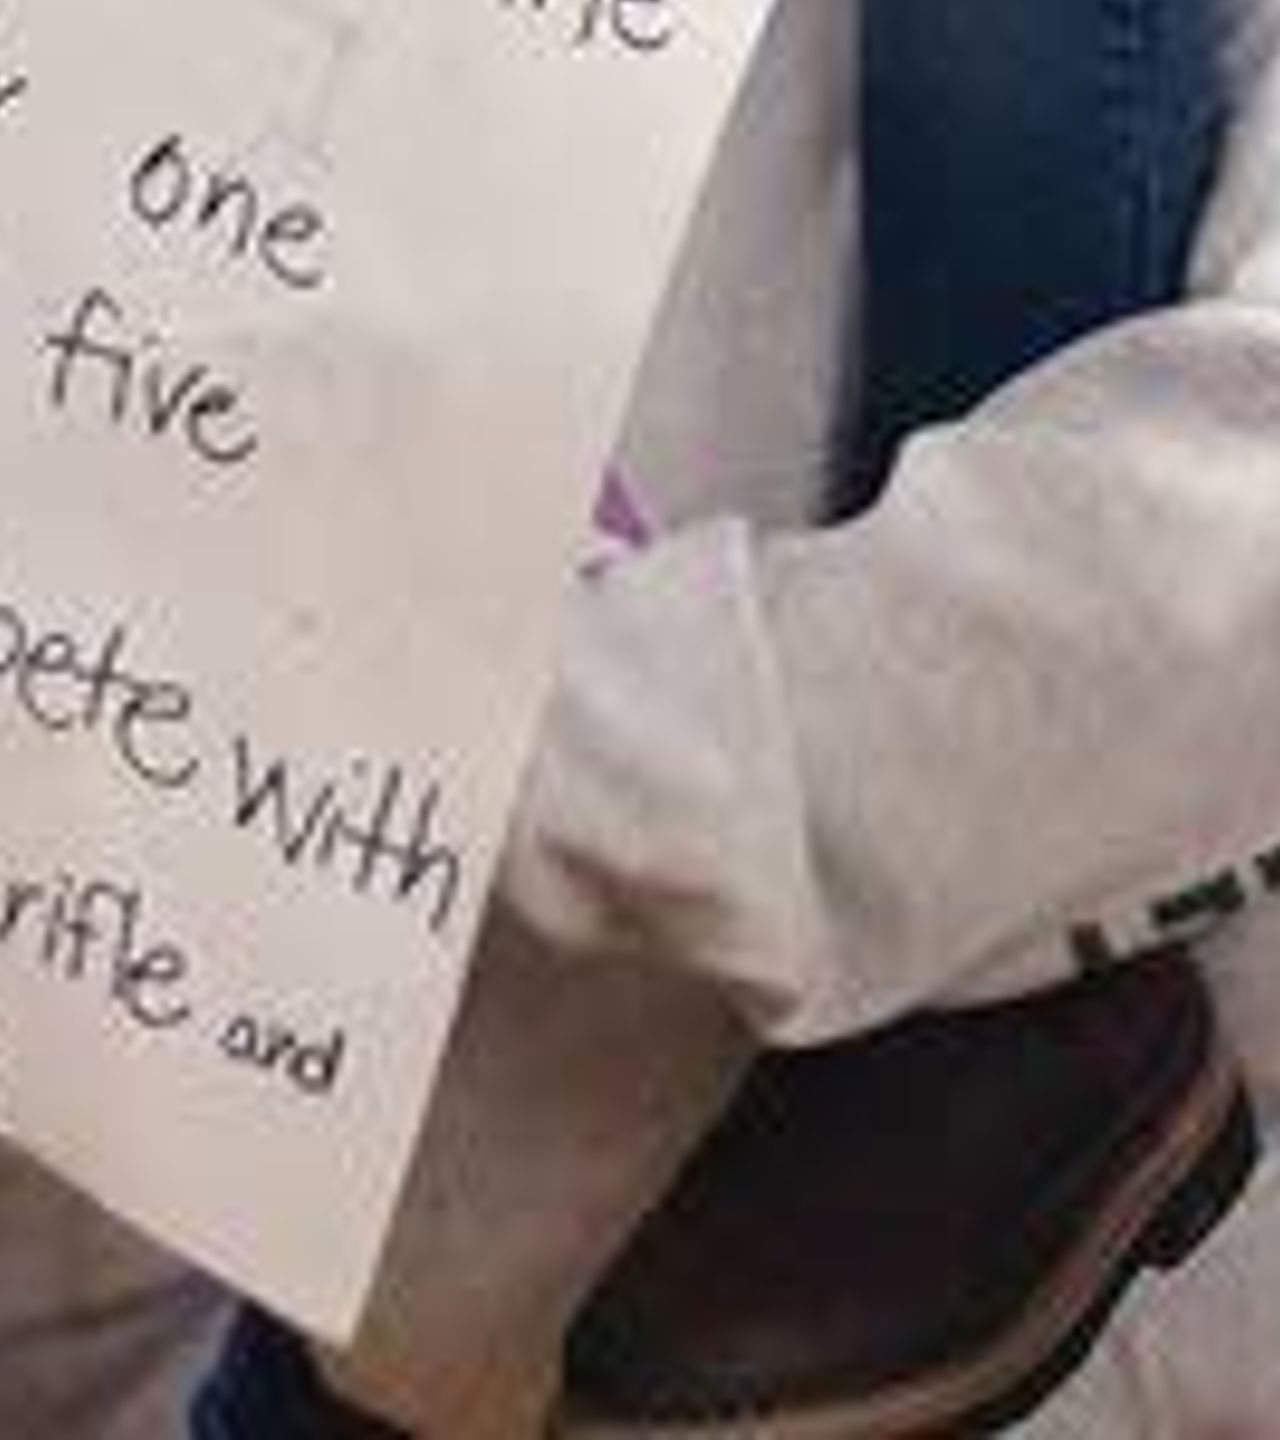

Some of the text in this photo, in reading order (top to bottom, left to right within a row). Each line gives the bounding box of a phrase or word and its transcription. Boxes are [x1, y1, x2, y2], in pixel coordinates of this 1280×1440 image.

[128, 132, 326, 288] one
[42, 288, 260, 466] five
[216, 1016, 346, 1098] and
